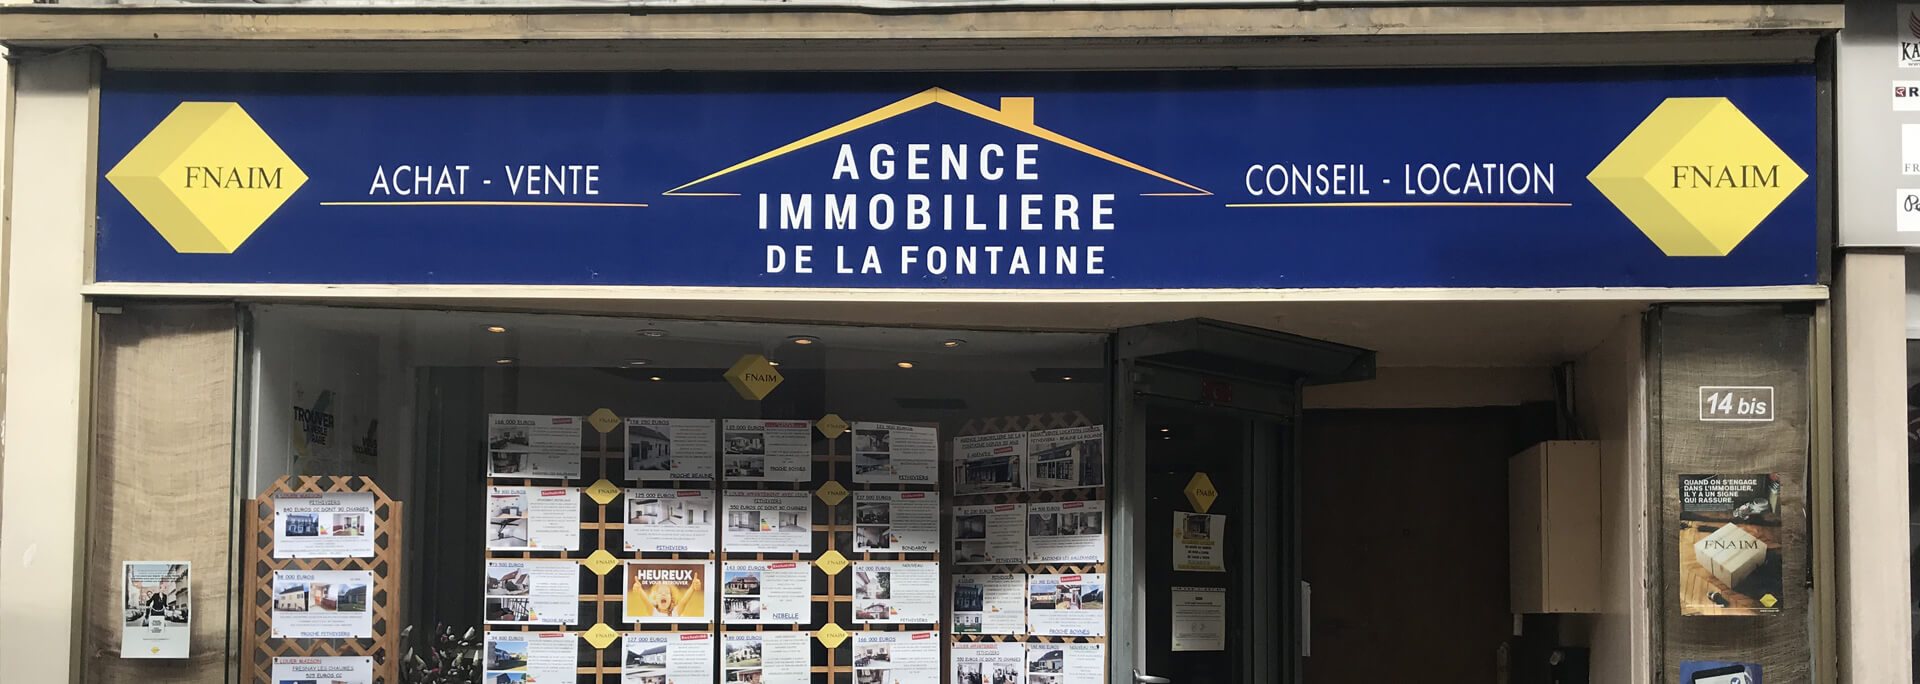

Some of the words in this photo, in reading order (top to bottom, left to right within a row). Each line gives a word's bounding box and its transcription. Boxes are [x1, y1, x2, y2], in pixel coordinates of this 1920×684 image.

[1901, 41, 1920, 61] KA
[832, 143, 1040, 181] AGENCE
[184, 165, 284, 190] FNAIM
[370, 164, 467, 196] ACHAT
[505, 164, 601, 196] VENTE
[1245, 163, 1370, 197] CONSEIL
[1405, 162, 1555, 196] LOCATION
[1671, 165, 1780, 190] FNAIM
[758, 193, 1116, 231] IMMOBILIERE
[766, 244, 813, 274] DE
[837, 245, 883, 275] LA
[901, 245, 1105, 275] FONTAINE
[746, 373, 777, 382] FNAIM
[1706, 392, 1733, 415] 14
[1737, 397, 1767, 415] bis
[294, 406, 334, 429] TROUVER
[1196, 488, 1215, 498] FNAIM
[1704, 540, 1759, 550] FNAIM
[637, 570, 693, 580] HEUREUX
